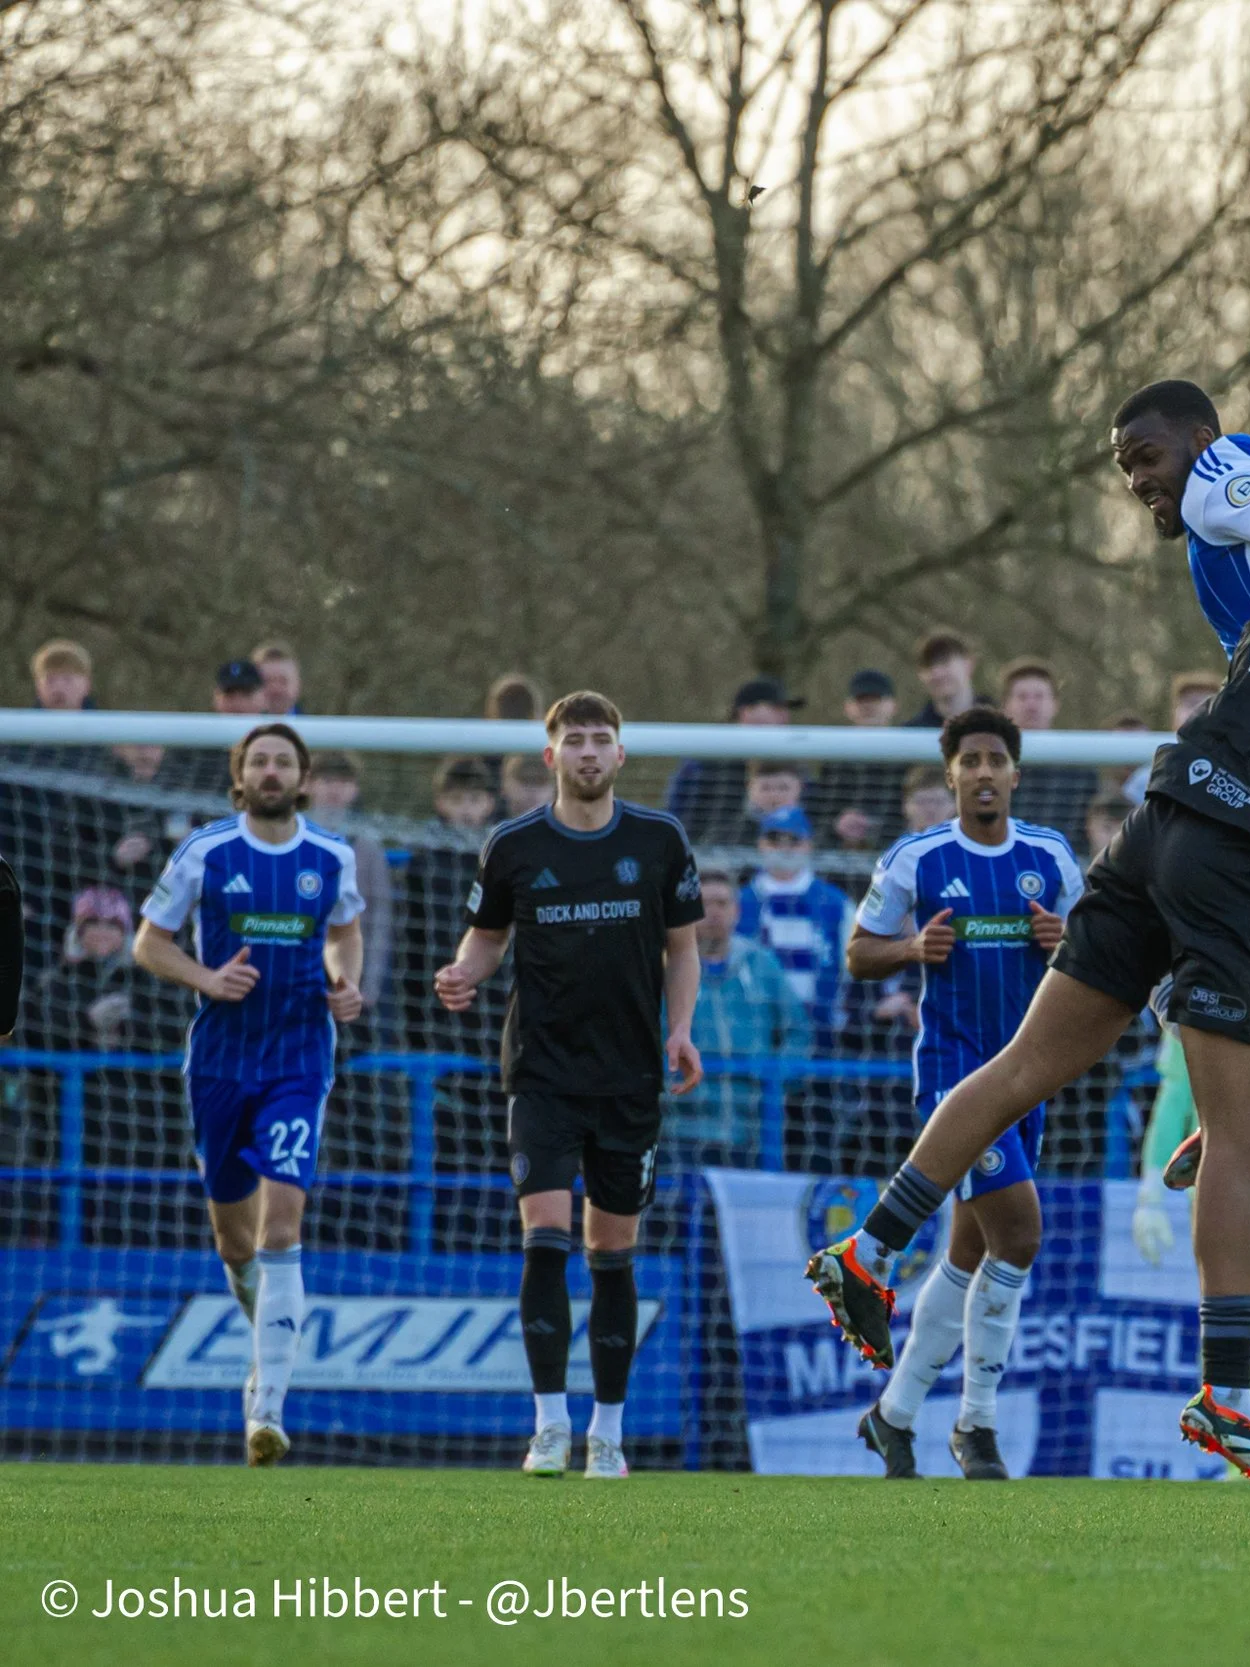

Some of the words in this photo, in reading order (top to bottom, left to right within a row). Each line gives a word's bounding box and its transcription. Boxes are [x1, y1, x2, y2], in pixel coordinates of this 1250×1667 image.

[1206, 783, 1244, 809] GROUP
[574, 903, 600, 921] AND
[602, 899, 641, 919] COVER
[242, 916, 305, 934] Pinnacle
[964, 920, 1031, 936] Pinnacle
[271, 1118, 310, 1161] 22
